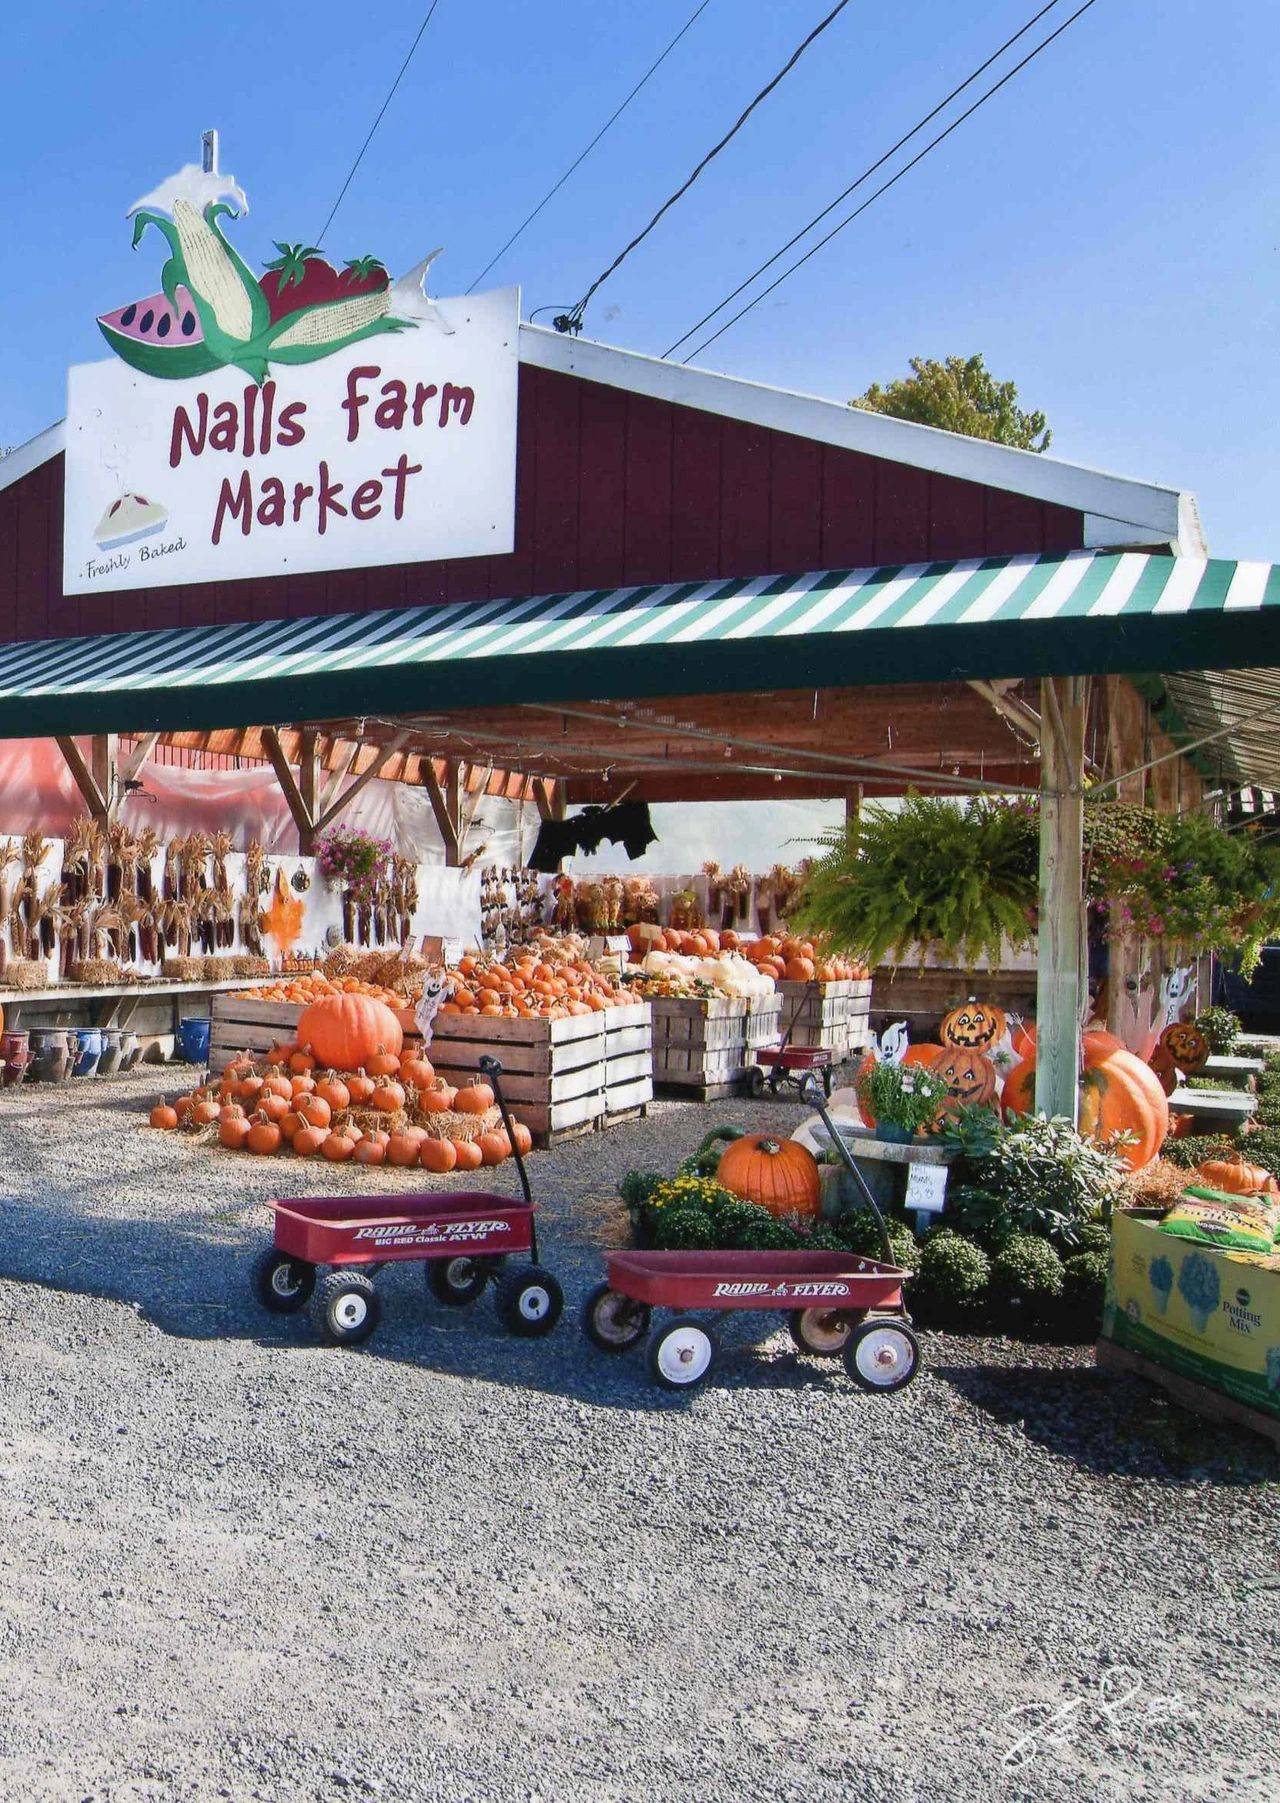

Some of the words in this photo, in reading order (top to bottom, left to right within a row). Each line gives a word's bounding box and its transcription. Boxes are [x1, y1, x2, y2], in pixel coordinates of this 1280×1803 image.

[169, 380, 308, 468] Nalls
[342, 365, 476, 442] Farm
[211, 453, 423, 546] Market
[85, 553, 131, 579] Freshly
[138, 537, 188, 562] Baked
[352, 1224, 419, 1240] RADIO
[441, 1220, 510, 1234] FLYER
[374, 1237, 392, 1246] BIG
[393, 1236, 414, 1245] RED
[415, 1234, 446, 1244] Classic
[449, 1232, 487, 1242] ATW
[712, 1282, 770, 1297] RADIO
[791, 1282, 850, 1296] FLYER
[1222, 1300, 1261, 1328] Potting
[1229, 1316, 1251, 1334] Mix
